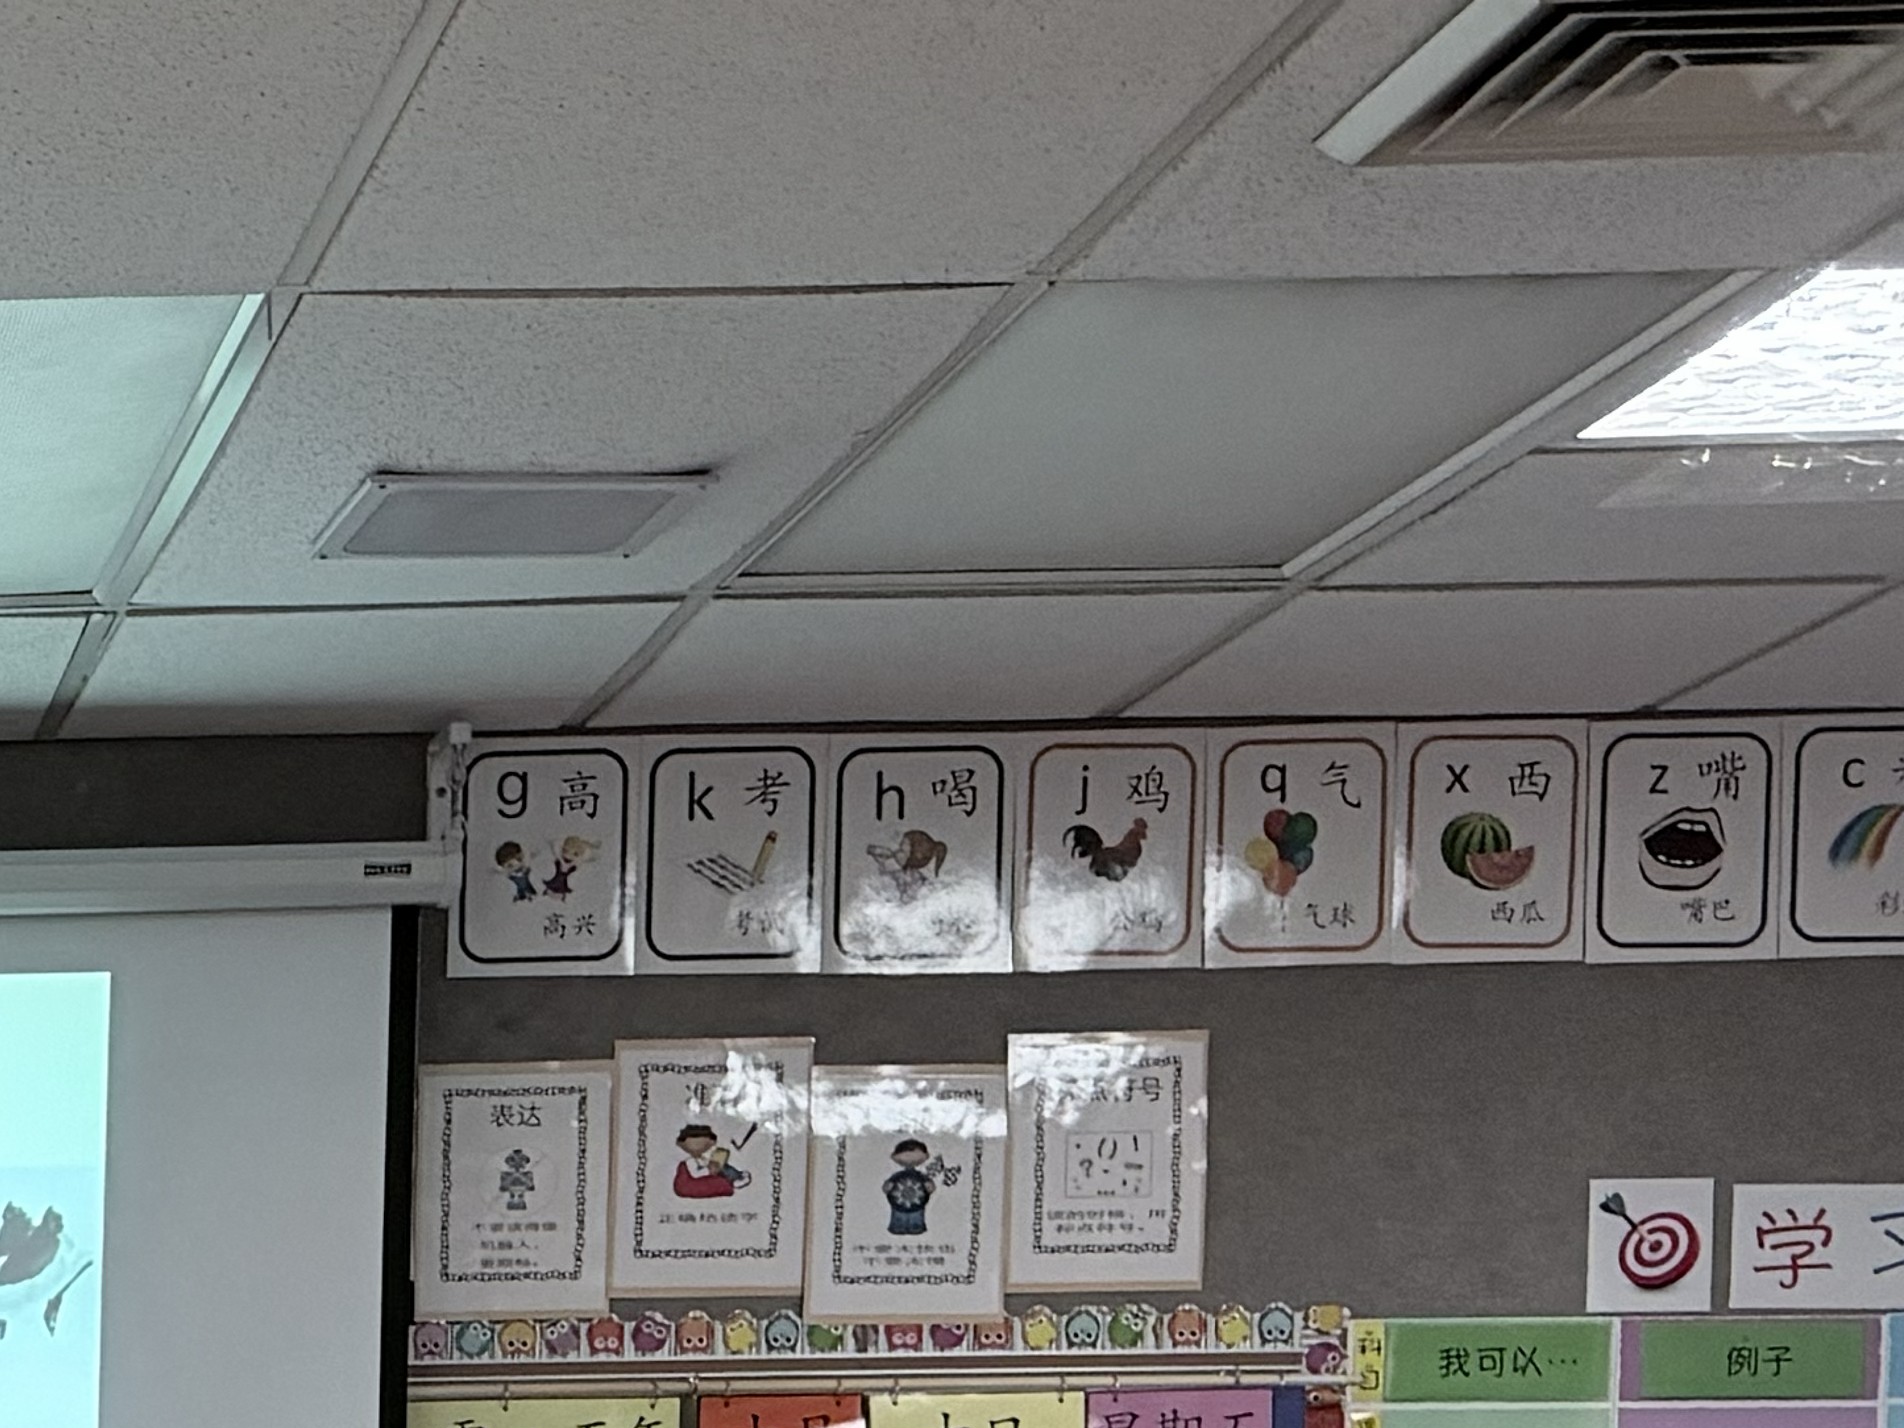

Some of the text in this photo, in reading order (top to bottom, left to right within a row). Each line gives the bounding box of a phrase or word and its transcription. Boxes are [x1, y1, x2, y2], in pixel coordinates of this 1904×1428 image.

[497, 770, 528, 818] g
[558, 771, 600, 819] 高
[688, 771, 716, 822] k
[744, 767, 791, 816] 考
[876, 771, 905, 820] h
[931, 769, 978, 818] 喝
[1074, 764, 1088, 816] j
[1124, 766, 1170, 814] 鸡
[1260, 763, 1287, 803] q
[1319, 760, 1362, 808] 气
[1508, 762, 1552, 802] 西
[1697, 753, 1746, 800] 嘴
[1726, 1345, 1792, 1379] 例子
